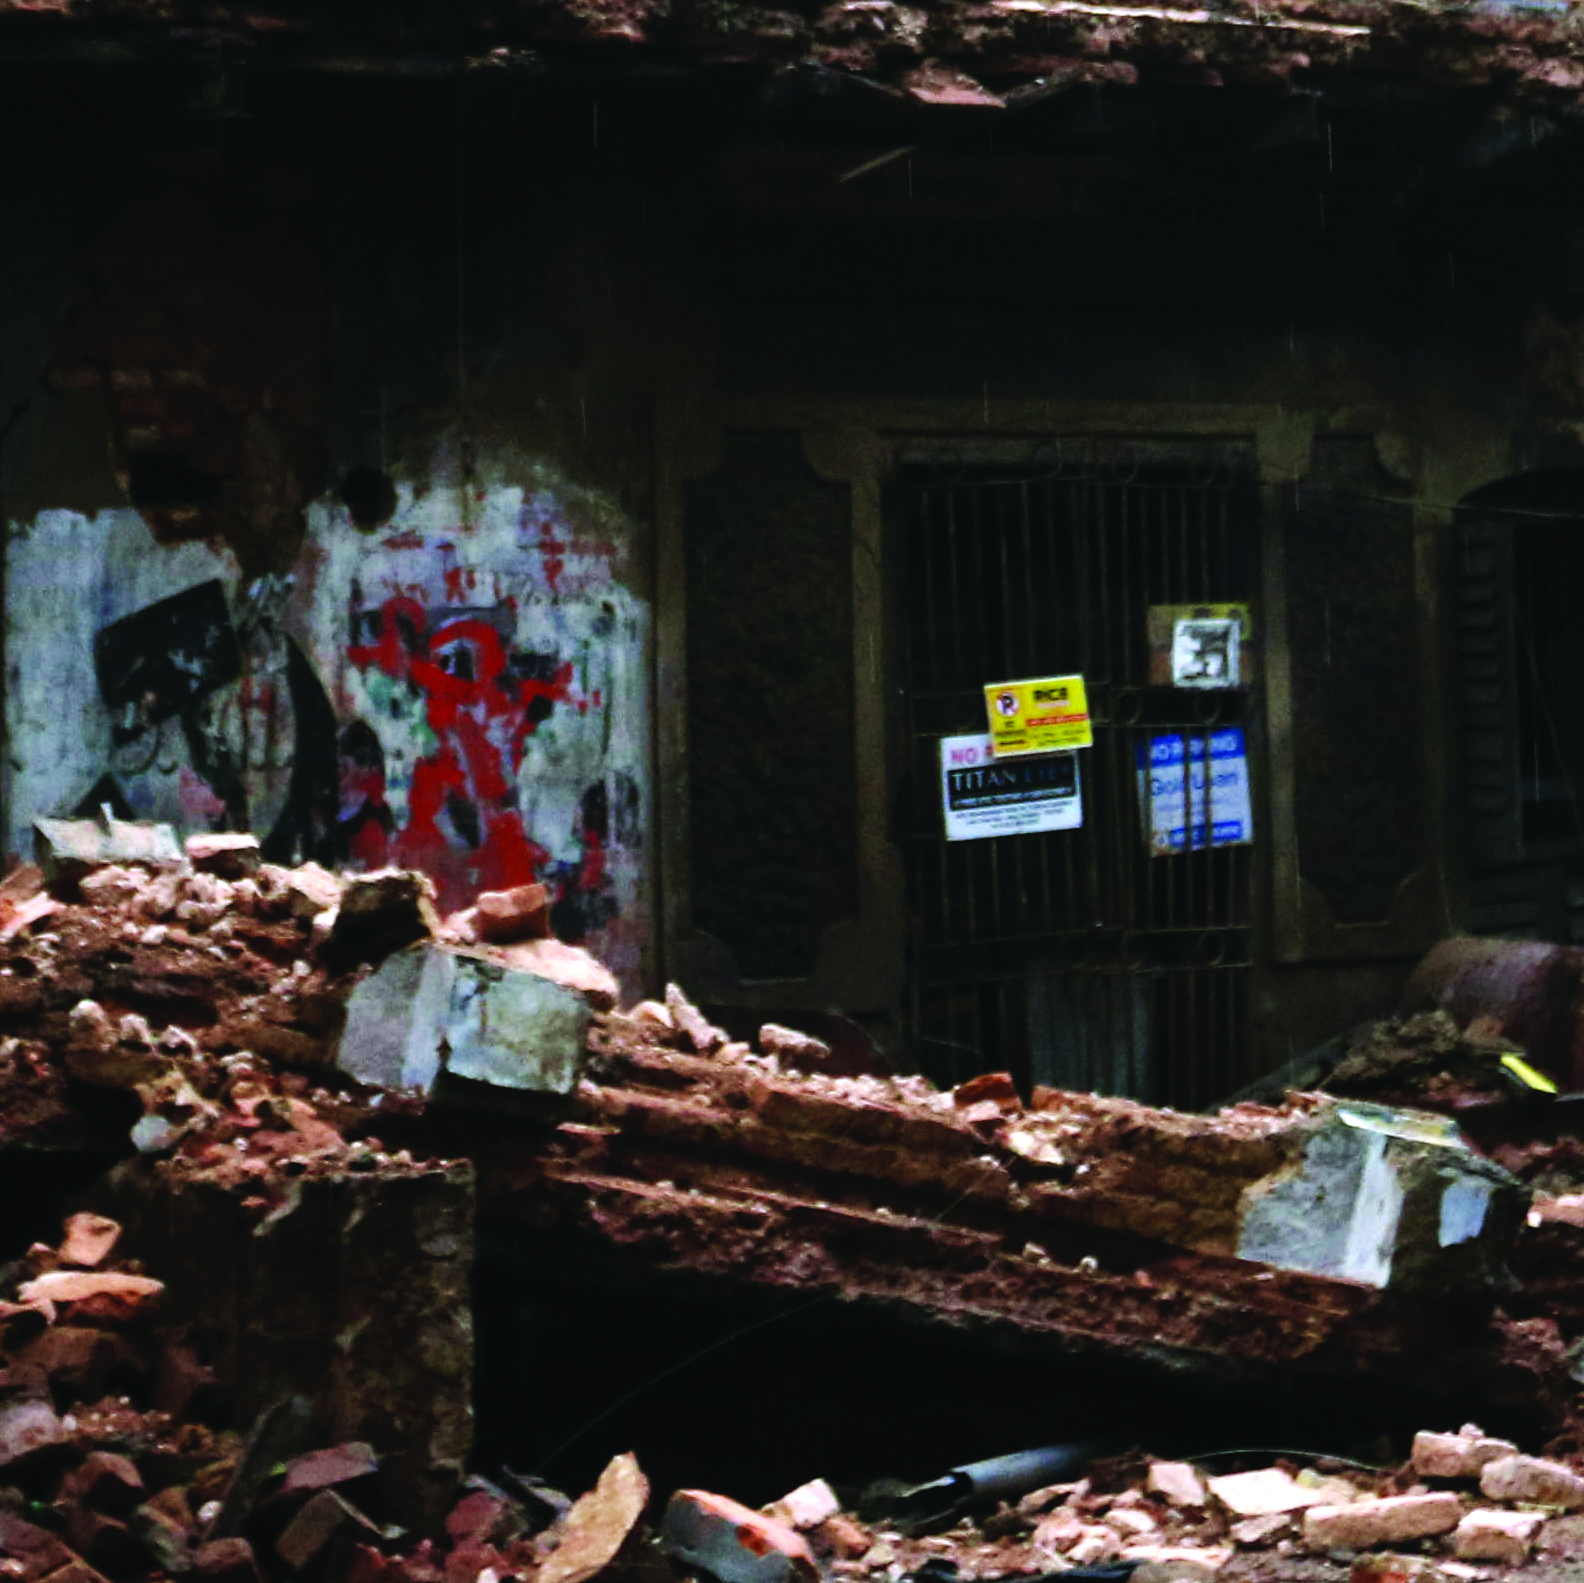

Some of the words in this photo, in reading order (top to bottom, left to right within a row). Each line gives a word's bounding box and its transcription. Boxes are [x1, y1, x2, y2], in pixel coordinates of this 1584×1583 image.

[950, 747, 977, 764] NO
[1171, 733, 1238, 757] PRING
[950, 769, 1016, 791] TITAN
